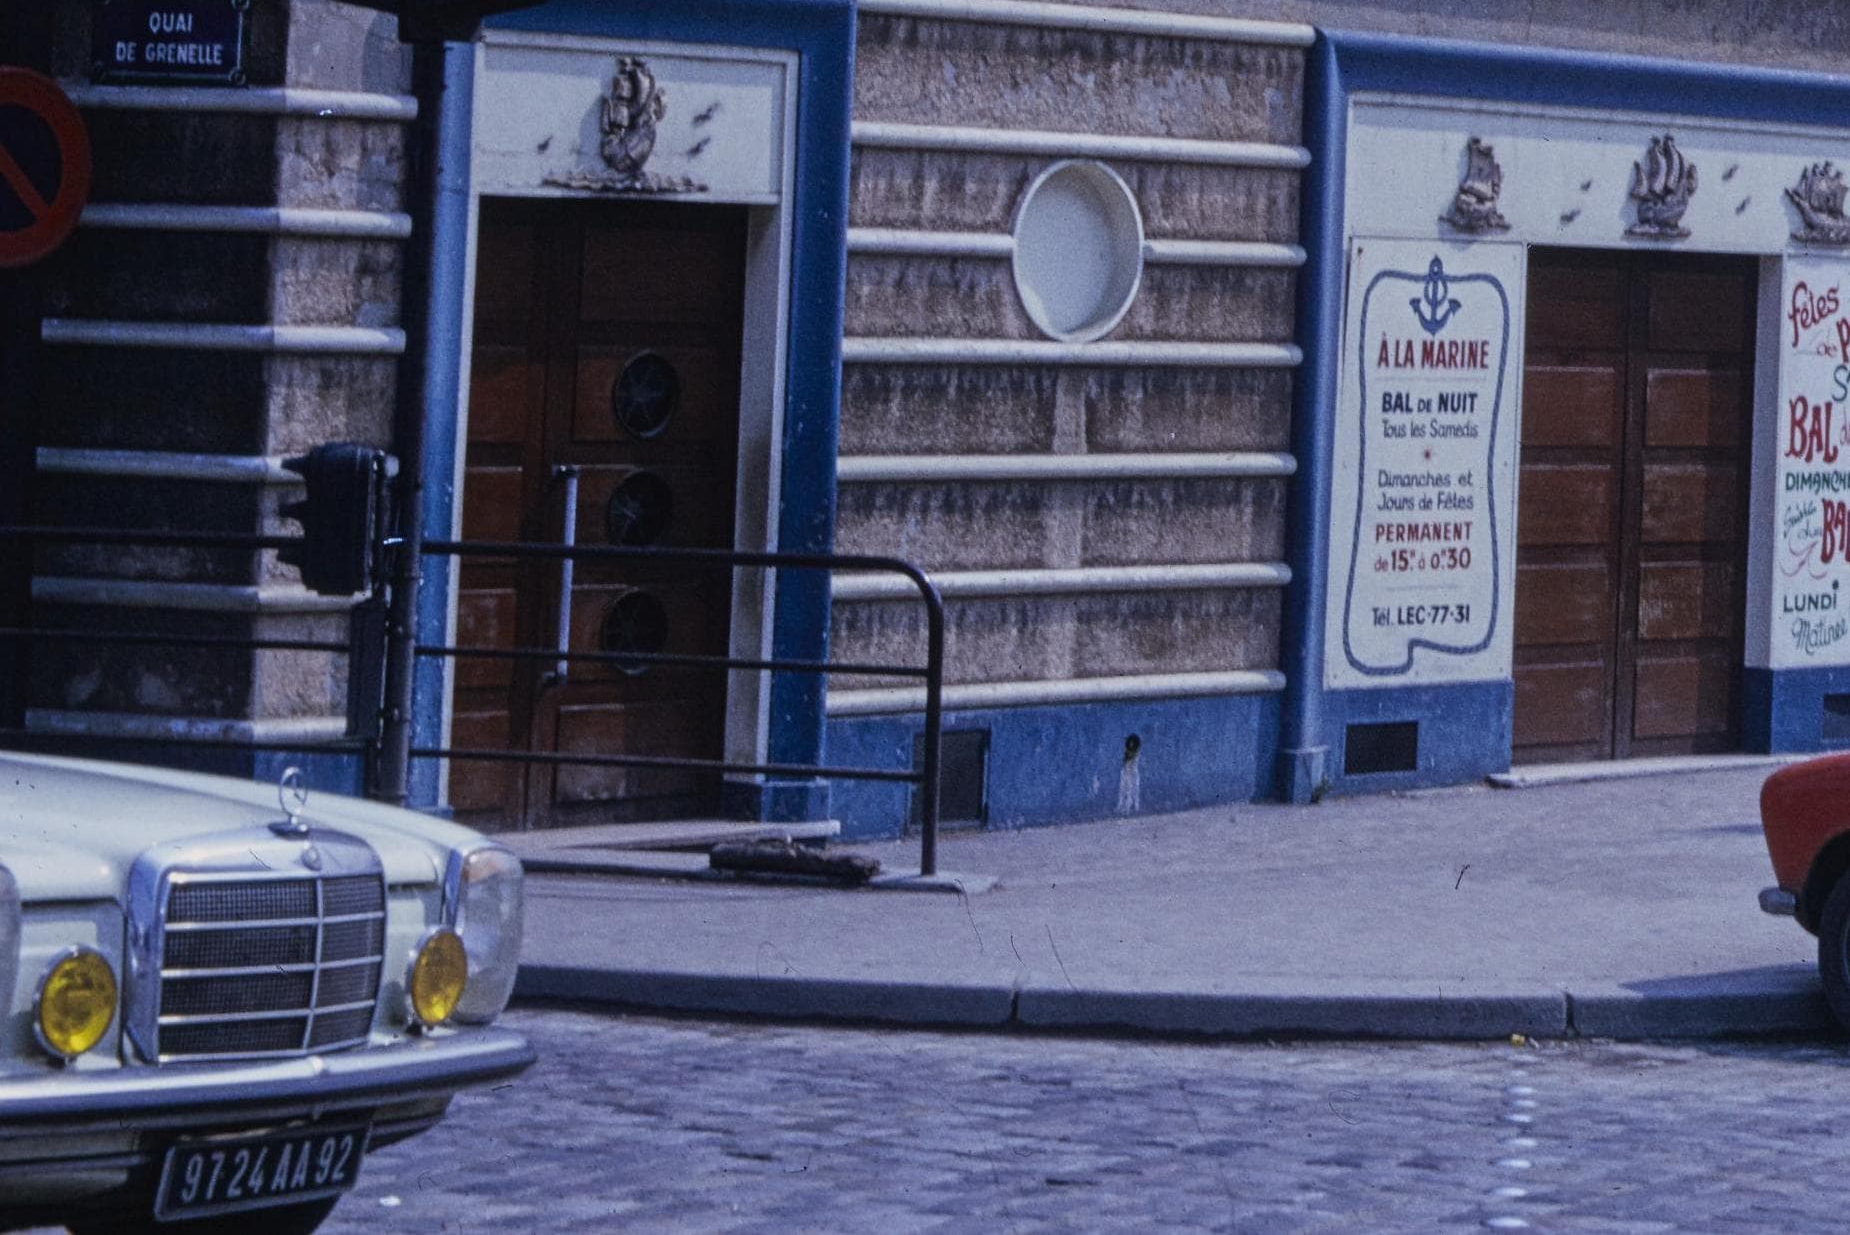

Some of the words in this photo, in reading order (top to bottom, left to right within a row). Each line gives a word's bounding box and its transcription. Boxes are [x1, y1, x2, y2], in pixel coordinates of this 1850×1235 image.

[149, 11, 194, 34] QUAI
[115, 40, 137, 62] DE
[144, 41, 224, 65] GRENELLE
[1394, 338, 1415, 369] LA
[1421, 339, 1490, 370] MARINE
[1381, 391, 1413, 414] BAL
[1417, 397, 1433, 414] DE
[1437, 391, 1478, 415] NUIT
[1381, 418, 1407, 438] Tous
[1410, 420, 1427, 438] les
[1429, 417, 1479, 439] Samedis
[1783, 394, 1839, 464] BAL
[1378, 468, 1452, 487] Dimanches
[1458, 469, 1474, 487] et
[1377, 491, 1415, 511] Jours
[1418, 492, 1433, 511] de
[1375, 521, 1474, 544] PERMANENT
[1374, 555, 1390, 573] de
[181, 1146, 269, 1203] 9724
[271, 1140, 312, 1191] AA
[315, 1133, 354, 1185] 92
